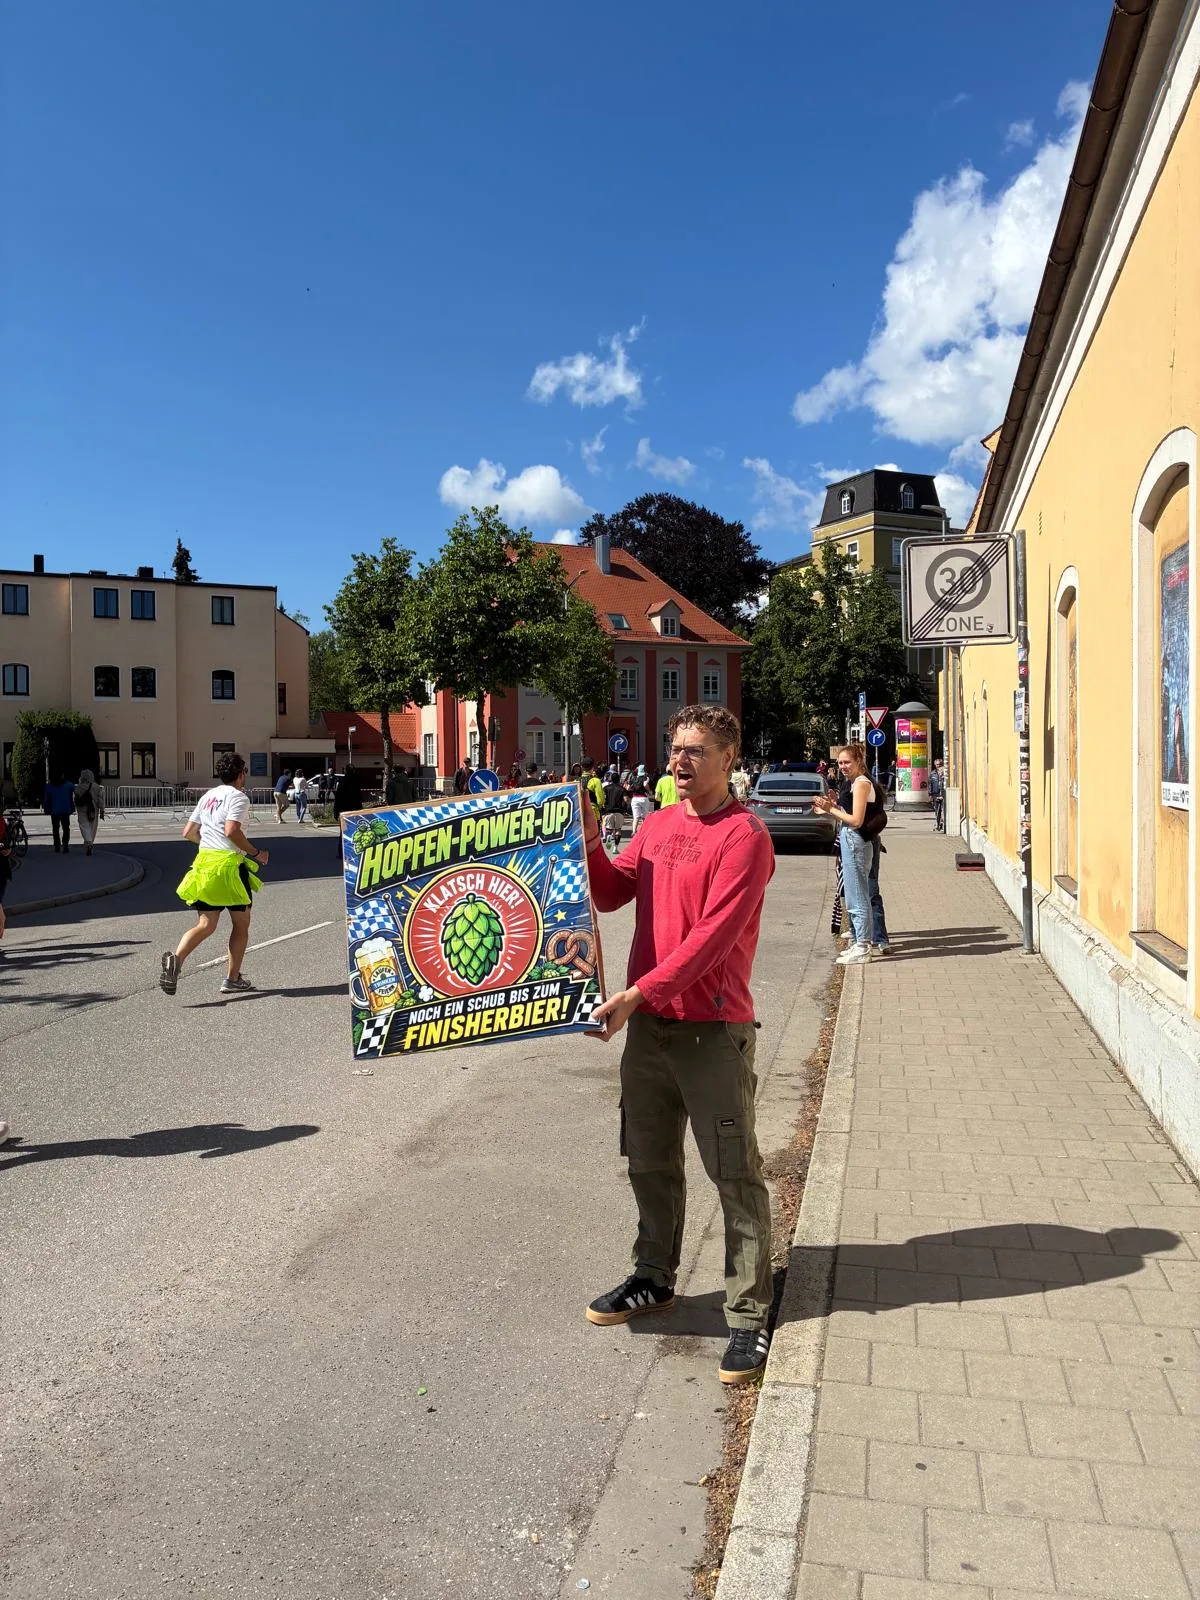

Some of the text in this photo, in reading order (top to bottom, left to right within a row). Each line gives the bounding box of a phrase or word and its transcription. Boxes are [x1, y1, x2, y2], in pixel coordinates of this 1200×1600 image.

[359, 800, 570, 890] HOPFEN-POWER-UP
[423, 873, 524, 913] KLATSCH HIER!
[373, 967, 391, 978] LAUFEN
[403, 995, 571, 1050] FINISHERBIER!
[408, 982, 561, 1025] NOCH EIN SCHUB BIS ZUM
